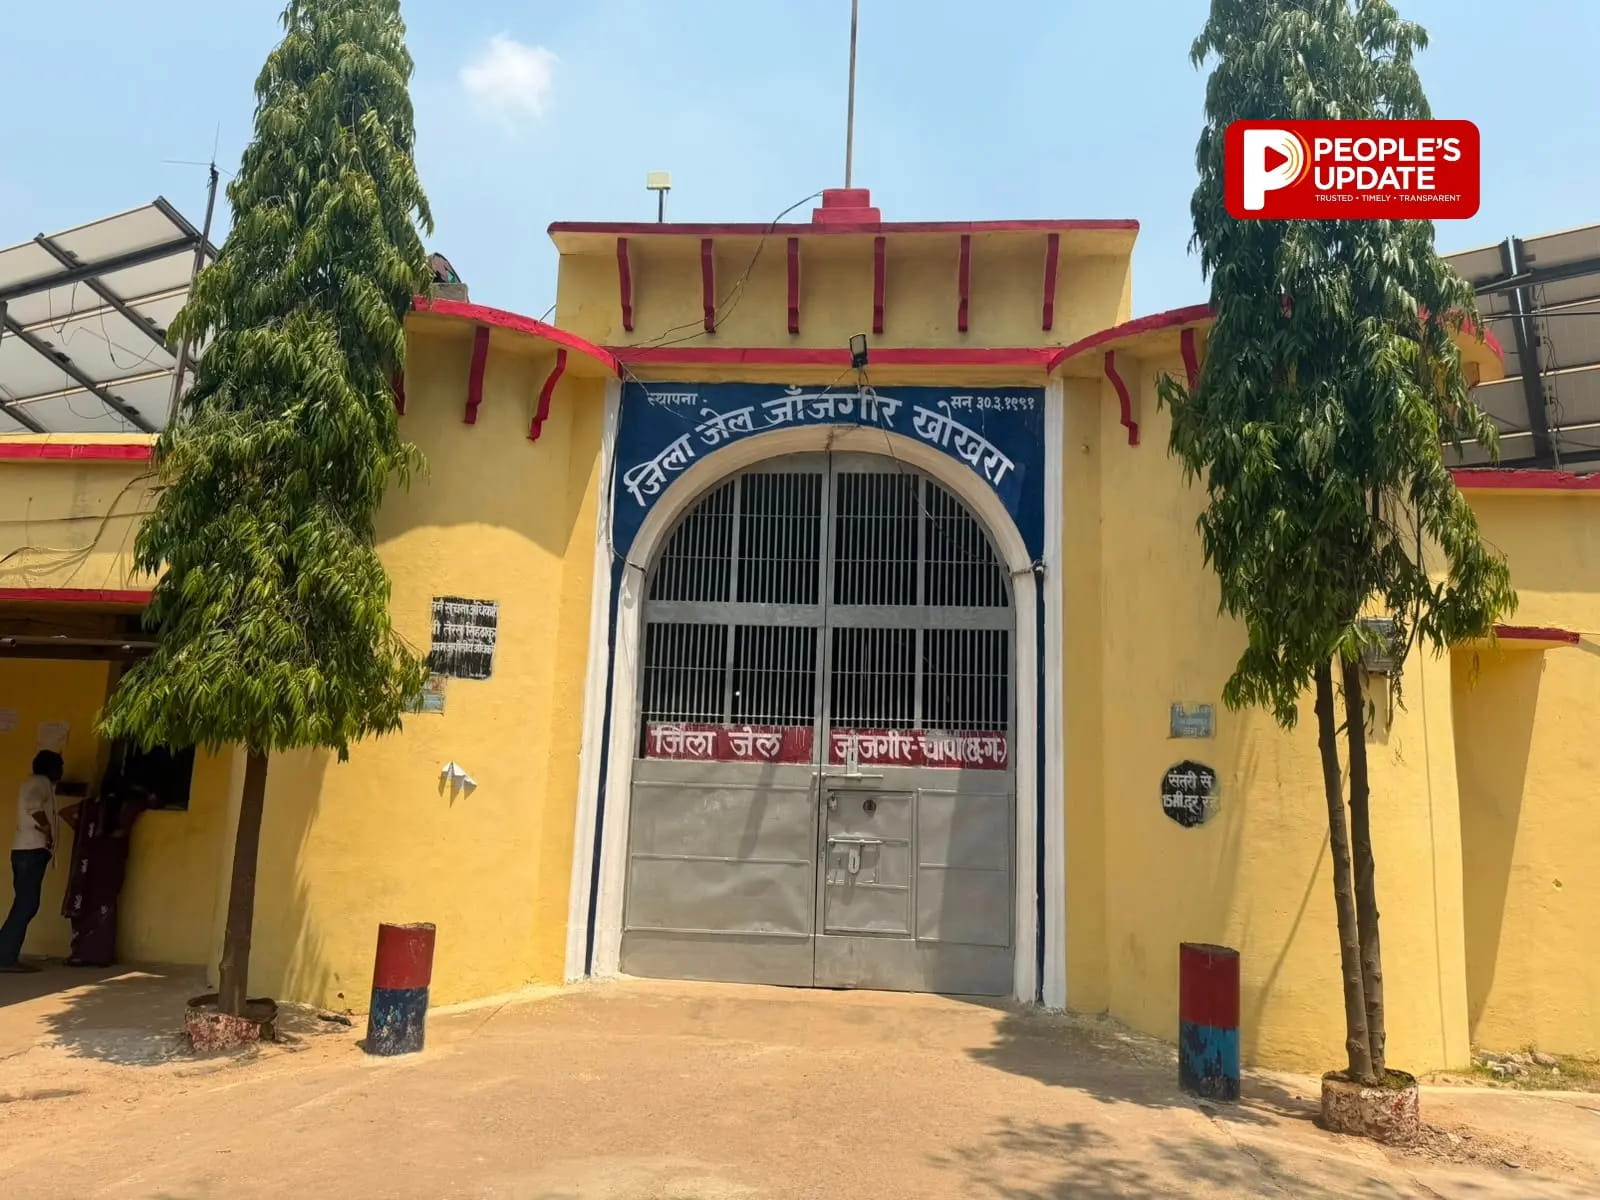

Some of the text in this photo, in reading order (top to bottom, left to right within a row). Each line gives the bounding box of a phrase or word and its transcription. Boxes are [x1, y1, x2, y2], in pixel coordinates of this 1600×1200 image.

[647, 392, 698, 406] स्थापना
[623, 433, 696, 507] जिला
[695, 406, 755, 444] जेल
[913, 400, 1015, 486] खोखरा
[650, 724, 717, 757] जिला
[728, 726, 783, 758] जेल
[1200, 771, 1212, 789] से
